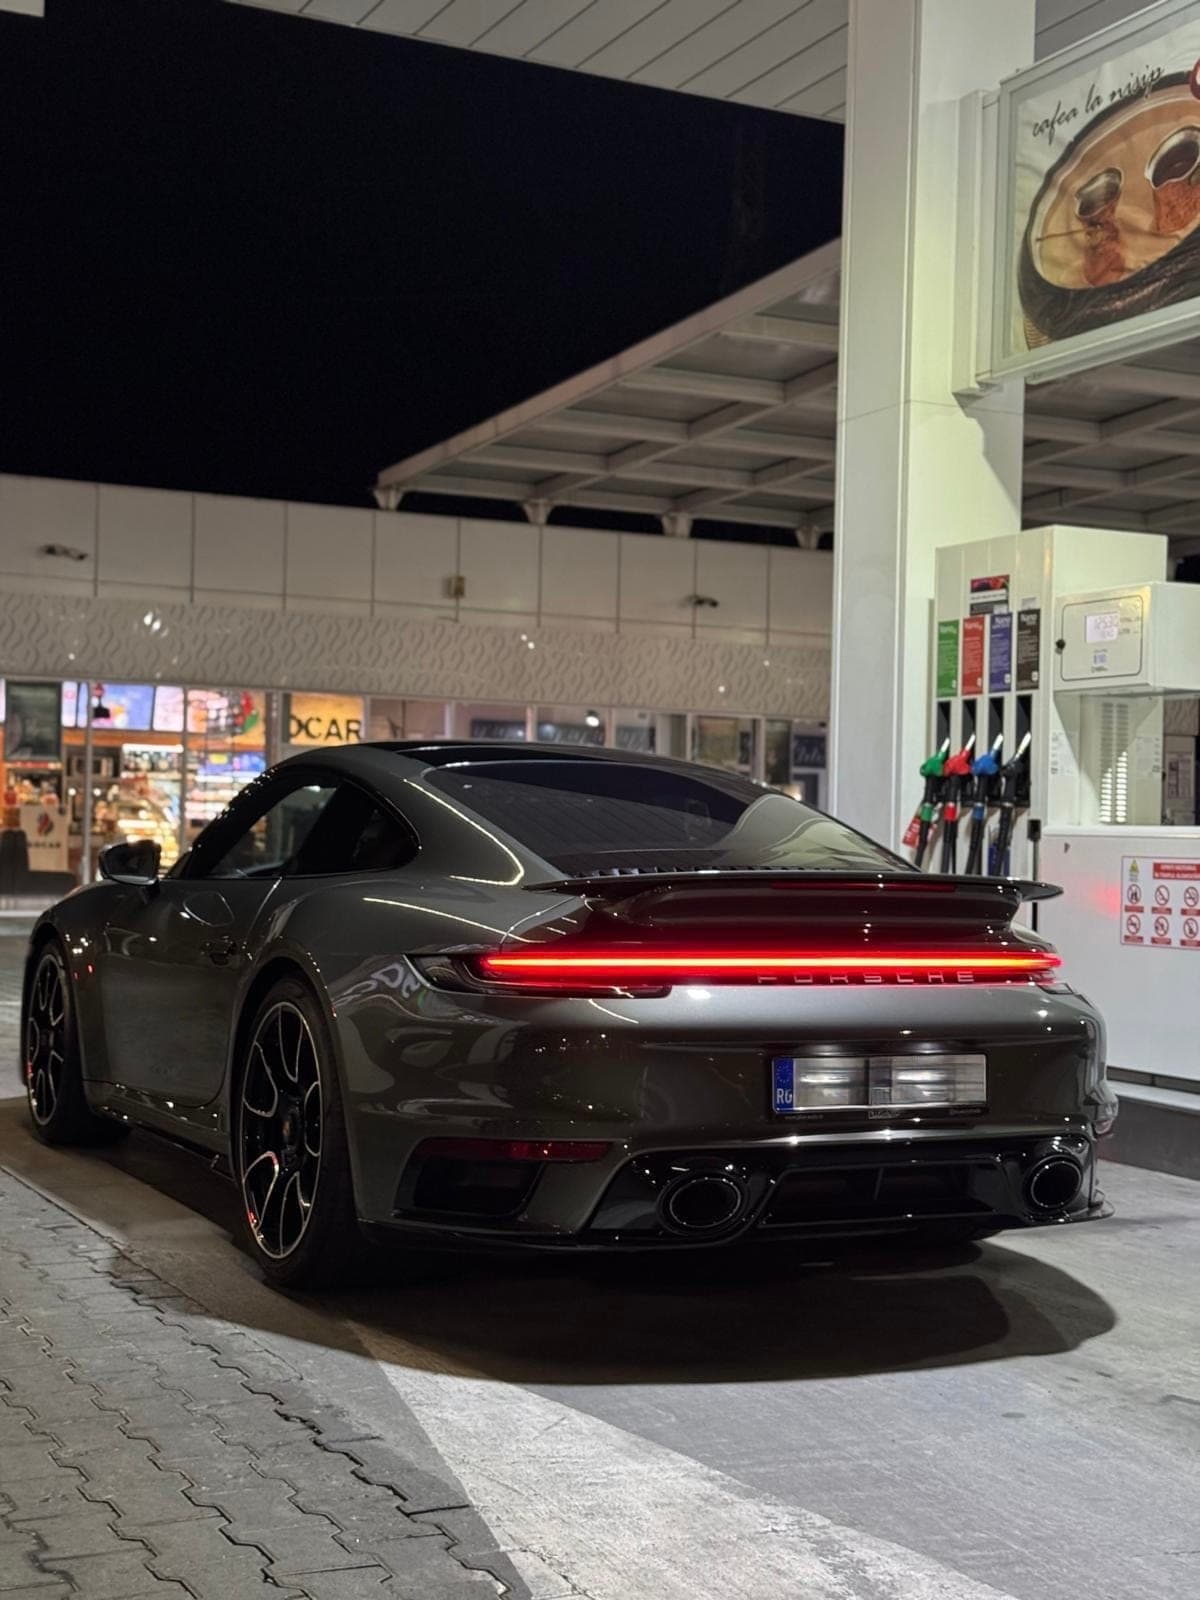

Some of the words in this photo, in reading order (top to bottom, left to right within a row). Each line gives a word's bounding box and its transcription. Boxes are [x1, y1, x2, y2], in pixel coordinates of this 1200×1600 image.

[1032, 100, 1079, 146] cafea
[1085, 83, 1104, 114] la
[1109, 64, 1166, 101] nisip
[757, 970, 975, 984] PORSCHE
